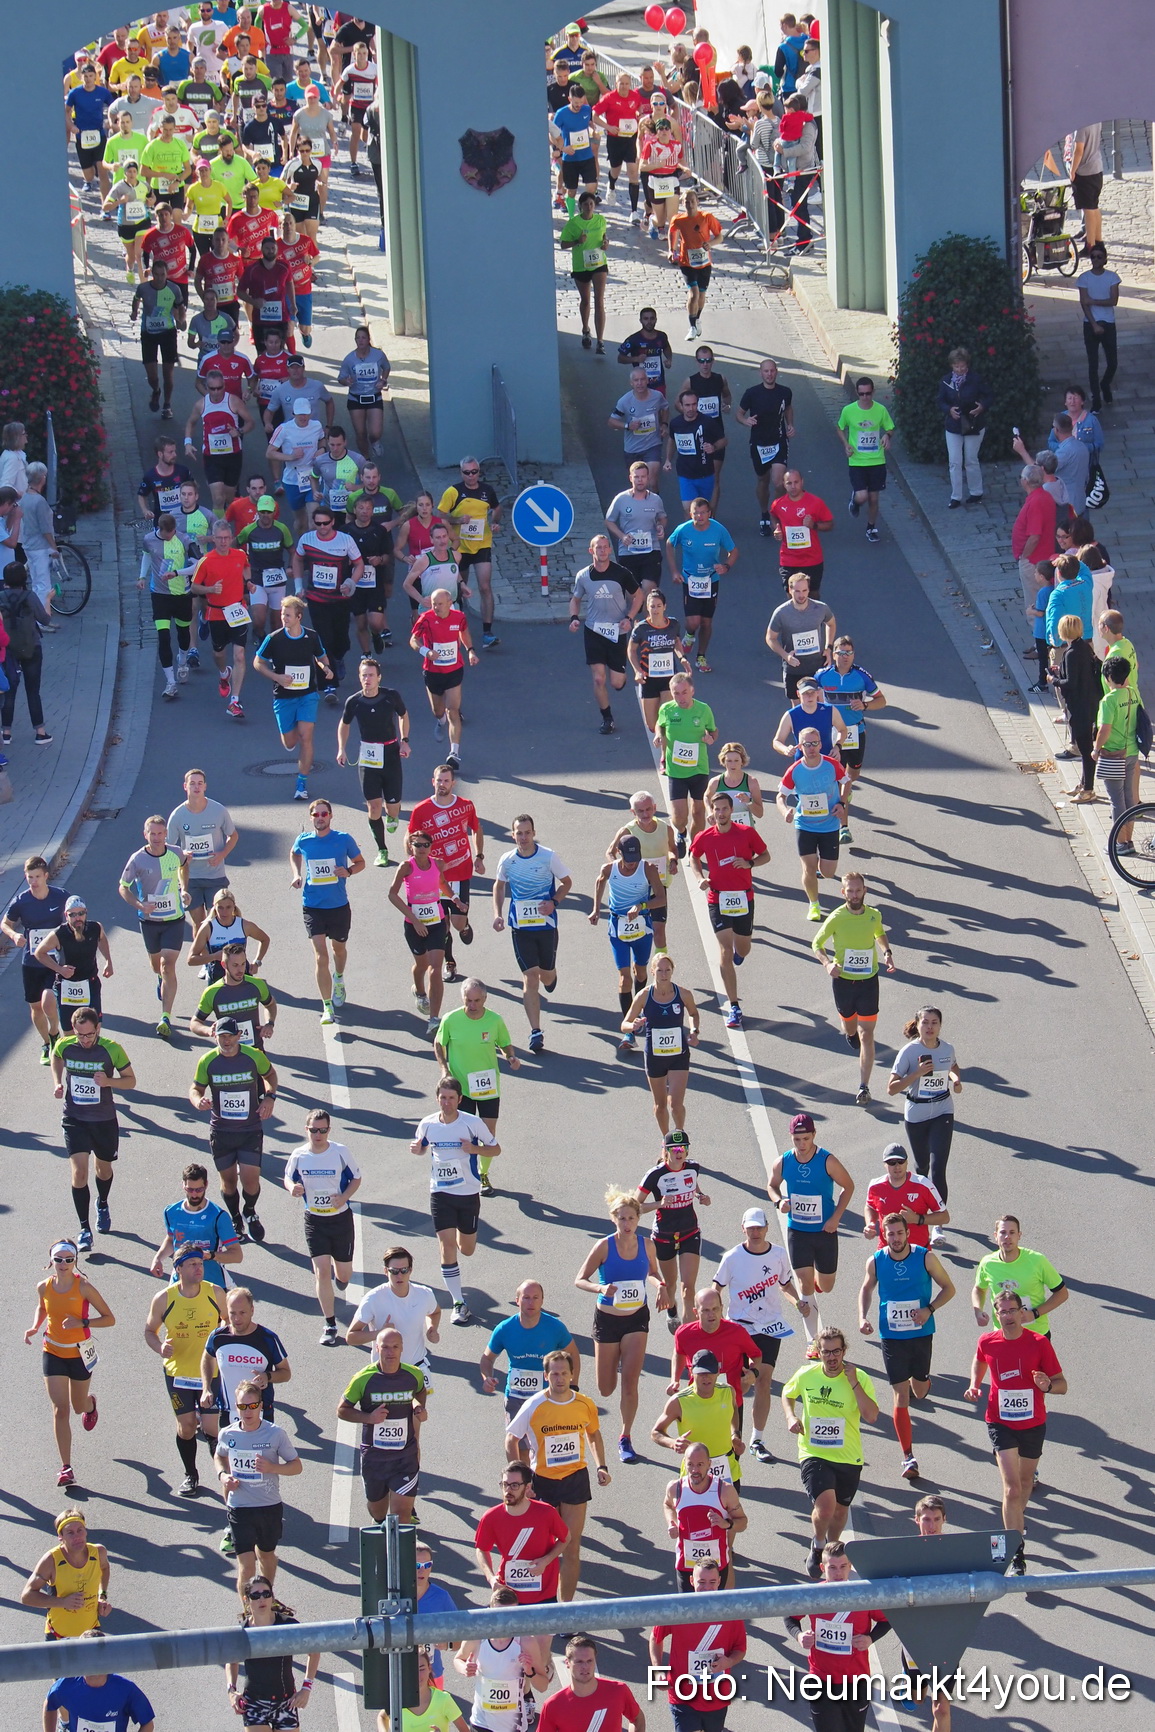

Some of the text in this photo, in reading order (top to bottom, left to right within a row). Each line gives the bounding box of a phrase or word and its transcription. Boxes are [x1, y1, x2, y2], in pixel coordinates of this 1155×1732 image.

[588, 253, 600, 261] 153
[263, 306, 279, 314] 2442
[358, 368, 375, 376] 2144
[699, 402, 716, 411] 2160
[213, 438, 227, 446] 270
[860, 436, 876, 444] 2172
[162, 493, 179, 503] 3064
[468, 524, 478, 532] 86
[631, 537, 648, 545] 2131
[791, 532, 804, 540] 253
[251, 541, 281, 550] BOCK
[265, 573, 283, 583] 2526
[316, 571, 334, 580] 2519
[230, 608, 244, 618] 158
[647, 634, 668, 642] HECK
[796, 637, 814, 647] 2597
[437, 648, 455, 657] 2335
[653, 659, 670, 668] 2018
[291, 672, 305, 681] 310
[367, 749, 375, 758] 94
[678, 748, 693, 757] 228
[809, 800, 819, 808] 73
[448, 804, 473, 818] raum
[189, 841, 210, 850] 2025
[315, 866, 330, 875] 340
[725, 897, 741, 906] 260
[418, 906, 434, 916] 206
[523, 907, 538, 916] 211
[624, 922, 639, 932] 224
[848, 956, 869, 965] 2353
[67, 987, 83, 996] 309
[218, 997, 257, 1012] BOCK
[659, 1036, 675, 1045] 207
[66, 1058, 105, 1072] BOCK
[211, 1071, 253, 1084] BOCK
[475, 1077, 491, 1088] 164
[924, 1078, 944, 1088] 2506
[74, 1083, 96, 1094] 2528
[223, 1098, 246, 1109] 2634
[437, 1167, 458, 1177] 2784
[314, 1196, 331, 1205] 232
[795, 1202, 817, 1212] 2077
[737, 1274, 779, 1300] FINISHER
[621, 1289, 639, 1299] 350
[746, 1290, 766, 1304] 2017
[761, 1321, 785, 1335] 3072
[228, 1354, 263, 1365] BOSCH
[513, 1376, 538, 1387] 2609
[370, 1391, 414, 1403] BOCK
[1003, 1397, 1029, 1408] 2465
[378, 1427, 404, 1438] 2530
[814, 1425, 840, 1435] 2296
[550, 1441, 575, 1454] 2246
[233, 1458, 256, 1470] 2143
[692, 1548, 712, 1558] 264
[820, 1629, 847, 1641] 2619
[489, 1689, 510, 1700] 200
